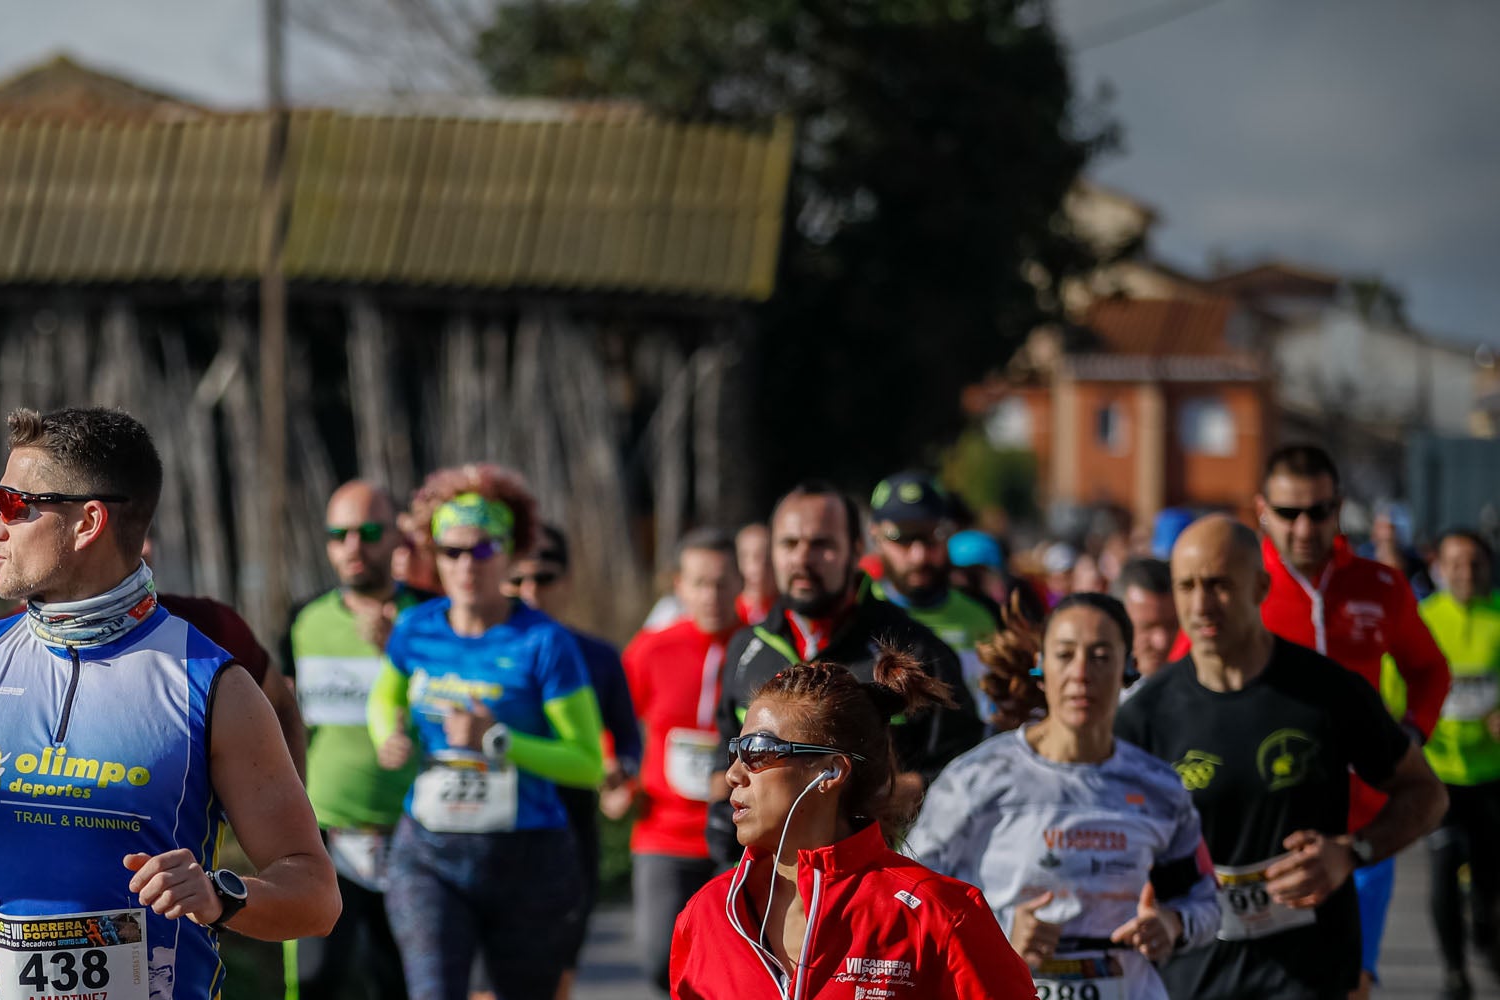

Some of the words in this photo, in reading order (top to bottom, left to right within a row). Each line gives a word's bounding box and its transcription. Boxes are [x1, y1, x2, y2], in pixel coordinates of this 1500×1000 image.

[14, 746, 151, 788] olimpo
[8, 778, 92, 799] deportes
[14, 811, 57, 825] TRAIL
[60, 815, 71, 827] &
[74, 816, 141, 832] RUNNING
[11, 923, 23, 940] VII
[22, 920, 83, 933] CARRERA
[23, 929, 84, 940] POPULAR
[11, 939, 20, 947] los
[21, 939, 57, 948] Secaderos
[18, 949, 110, 992] 438
[846, 957, 863, 974] VII
[862, 958, 912, 970] CARRERA
[862, 967, 910, 978] POPULAR
